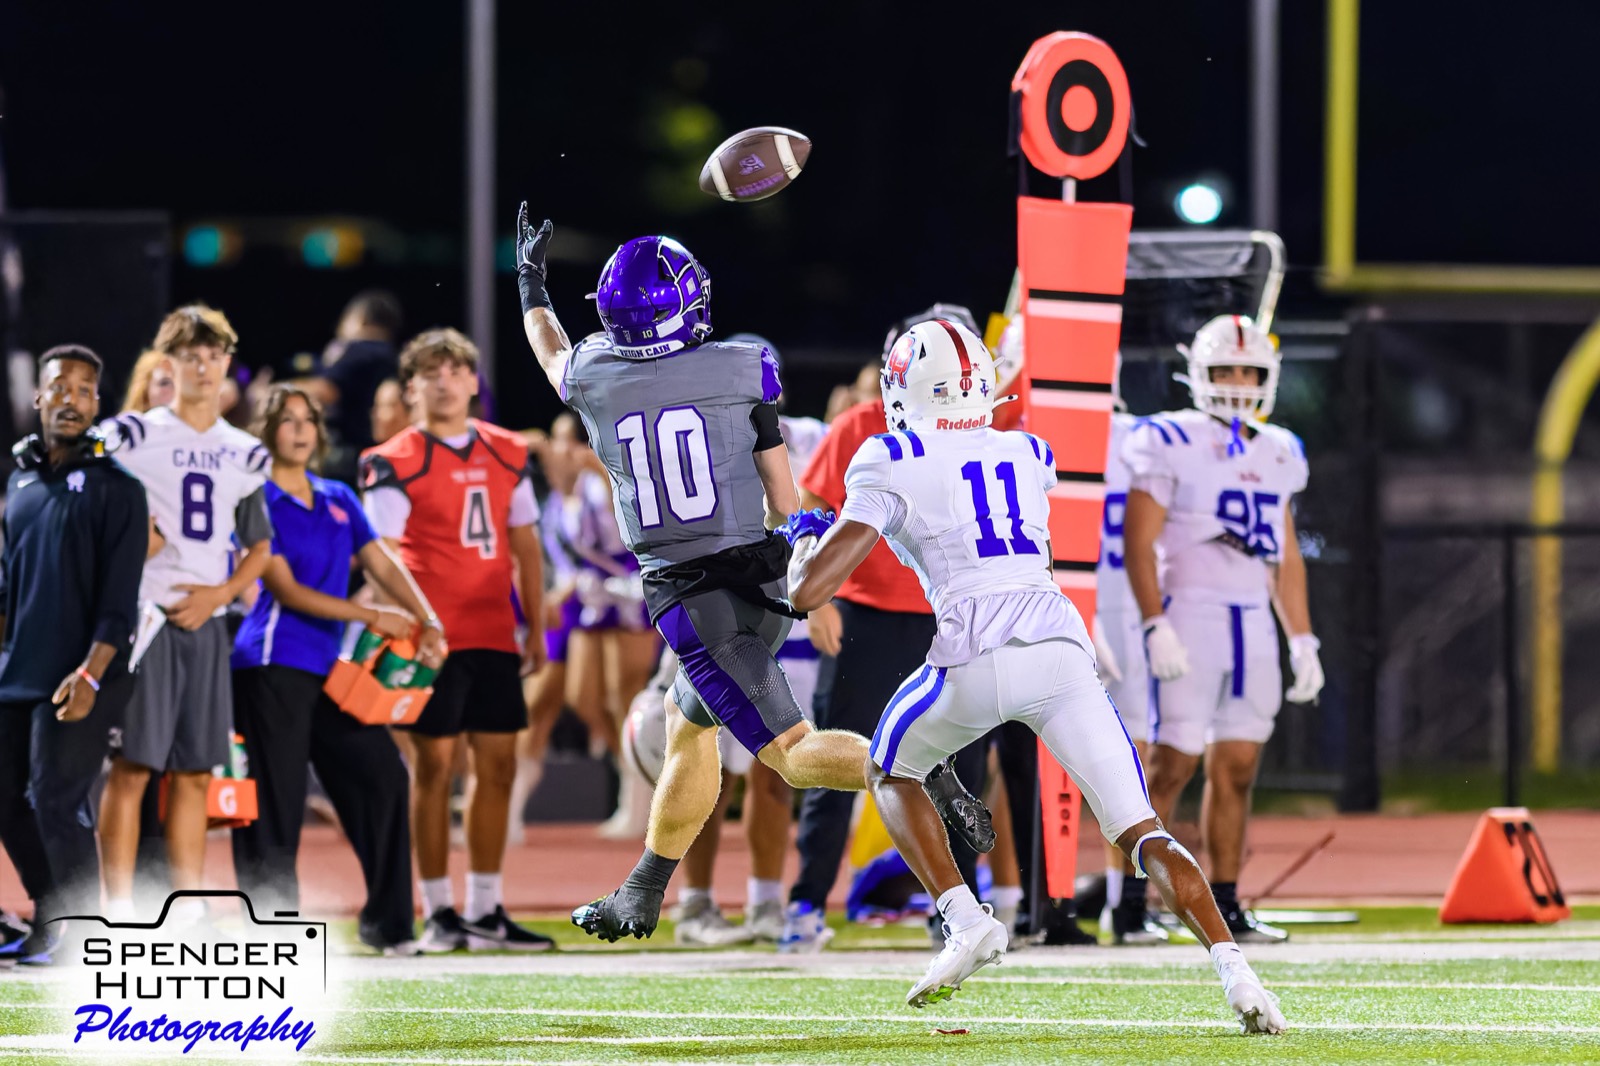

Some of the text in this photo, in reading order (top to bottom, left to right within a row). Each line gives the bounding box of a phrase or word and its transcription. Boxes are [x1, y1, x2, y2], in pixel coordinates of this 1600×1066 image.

[642, 329, 653, 339] 10
[645, 344, 671, 357] CAIN
[936, 414, 987, 430] Riddell
[172, 448, 221, 471] CAIN
[614, 404, 720, 531] 10
[182, 472, 214, 542] 8
[460, 486, 498, 560] 4
[960, 460, 1041, 559] 11
[1216, 490, 1281, 559] 95
